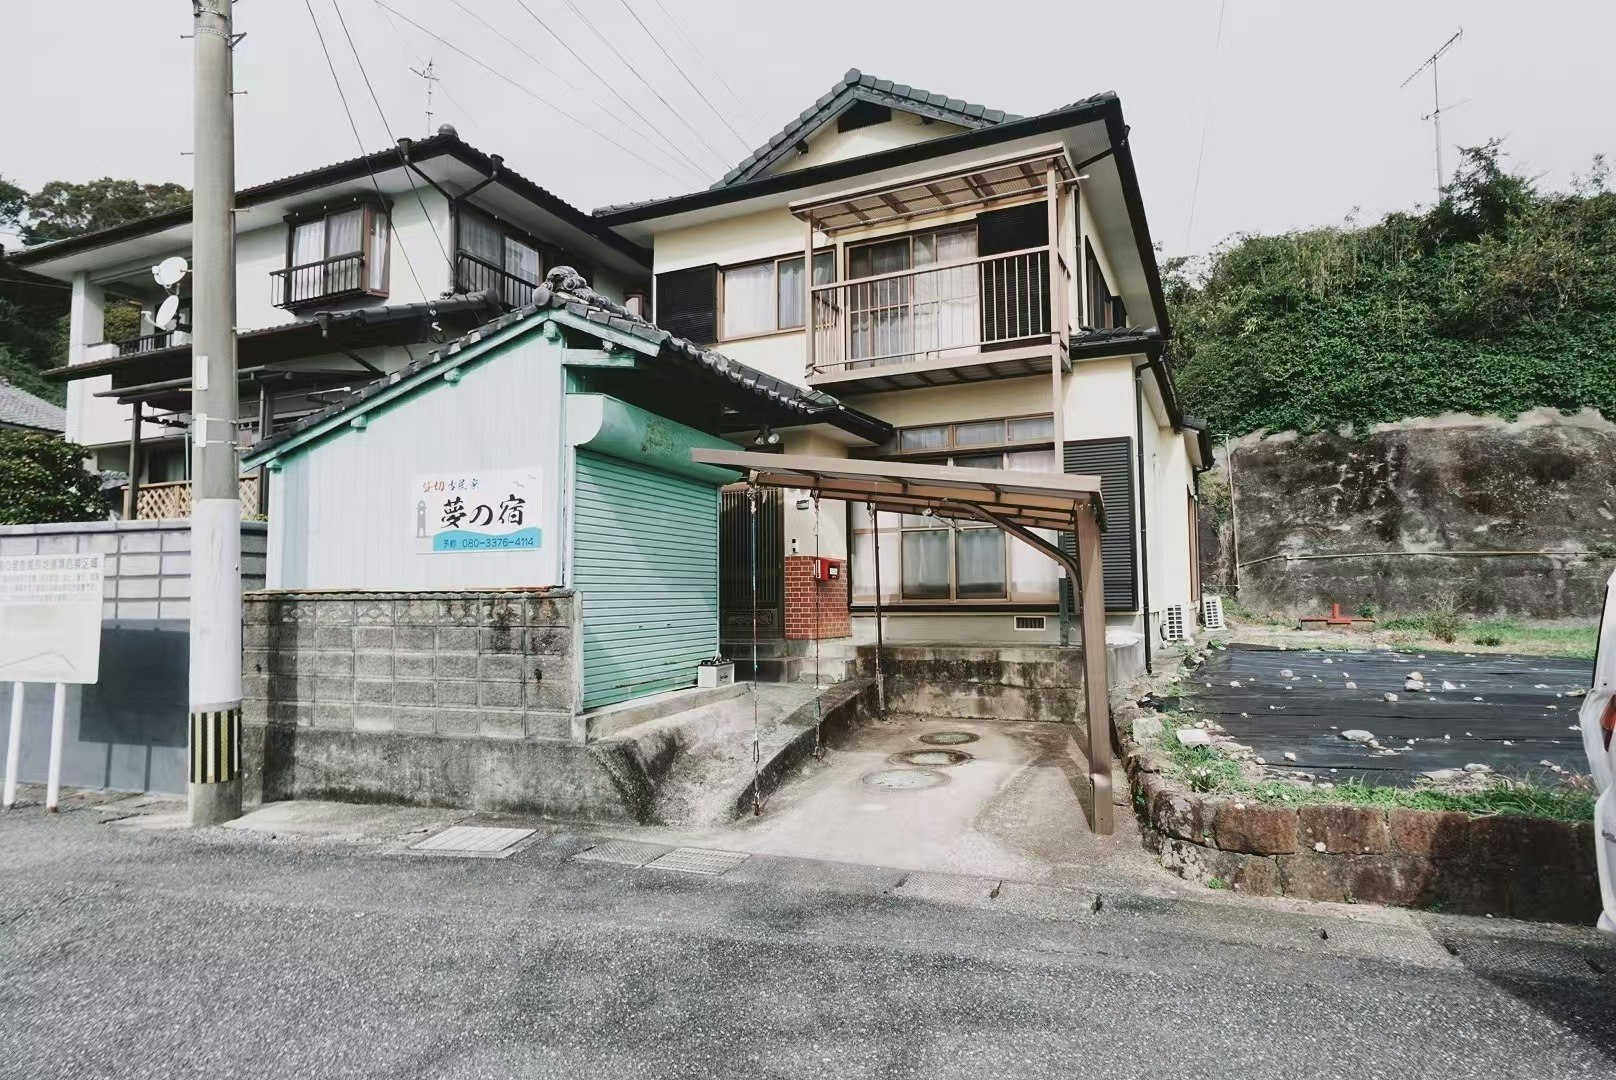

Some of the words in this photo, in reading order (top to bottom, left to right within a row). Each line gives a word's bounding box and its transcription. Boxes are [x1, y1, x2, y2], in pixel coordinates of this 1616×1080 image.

[441, 494, 526, 528] 夢の宿
[462, 537, 534, 548] 080-3376-4114
